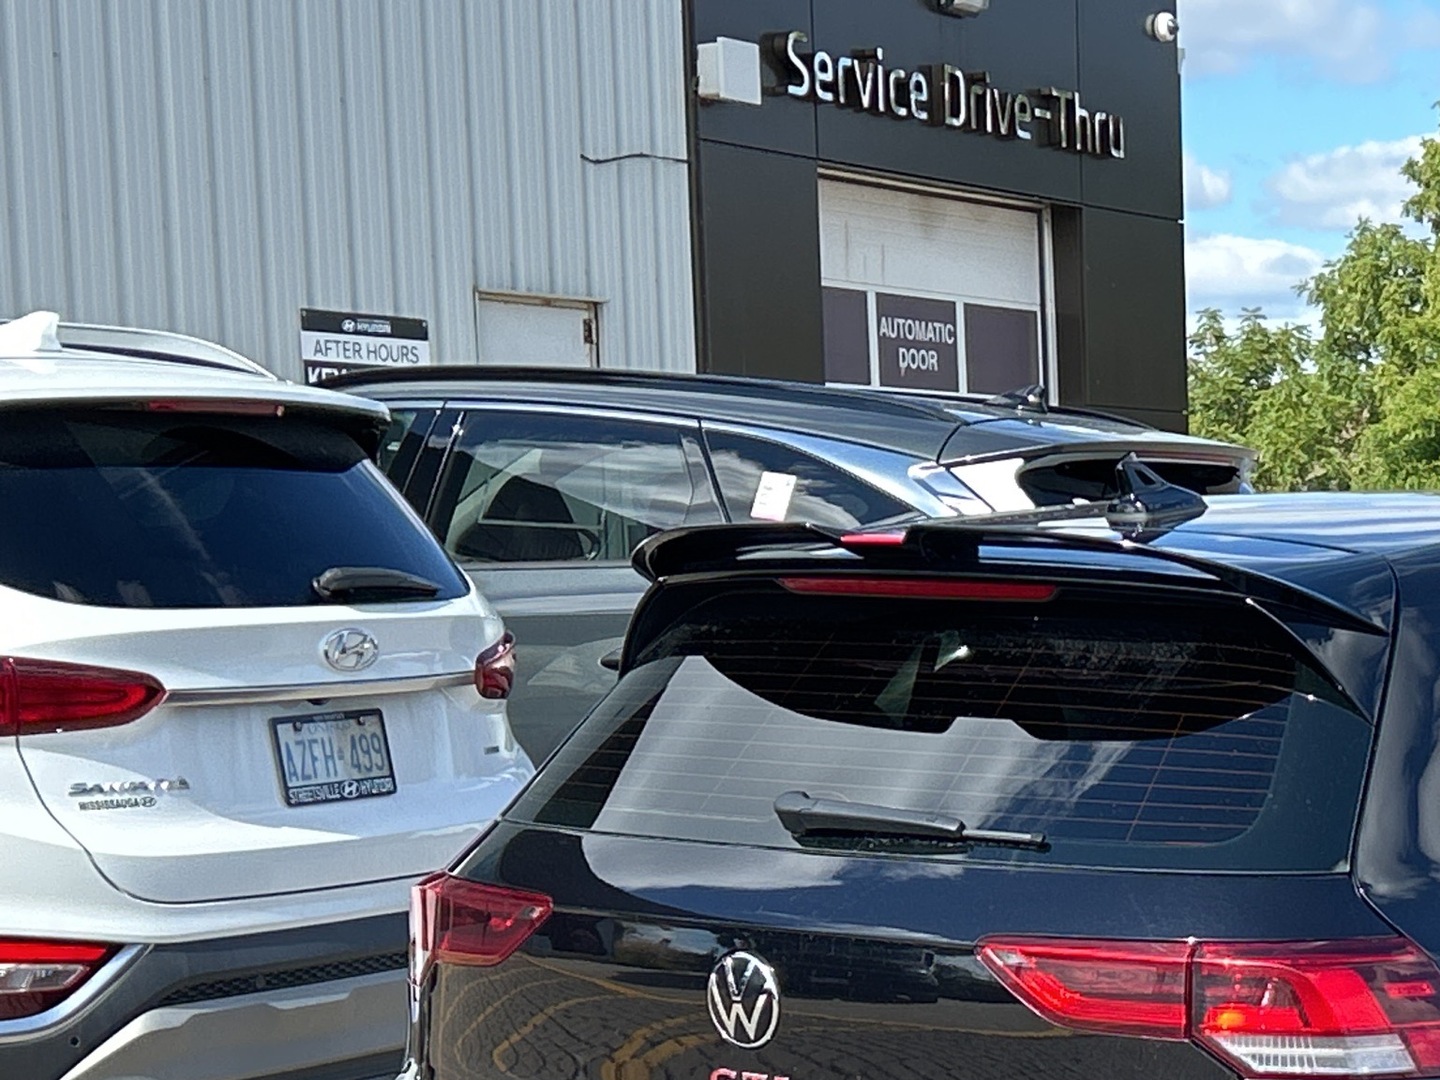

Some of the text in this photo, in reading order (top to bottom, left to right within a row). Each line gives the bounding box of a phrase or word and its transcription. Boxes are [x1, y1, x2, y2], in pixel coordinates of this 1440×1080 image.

[786, 30, 1125, 159] Service Drive-Thru
[879, 316, 955, 345] AUTOMATIC
[313, 338, 420, 364] AFTER HOURS
[898, 346, 939, 372] DOOR
[284, 731, 385, 783] AZFH 499
